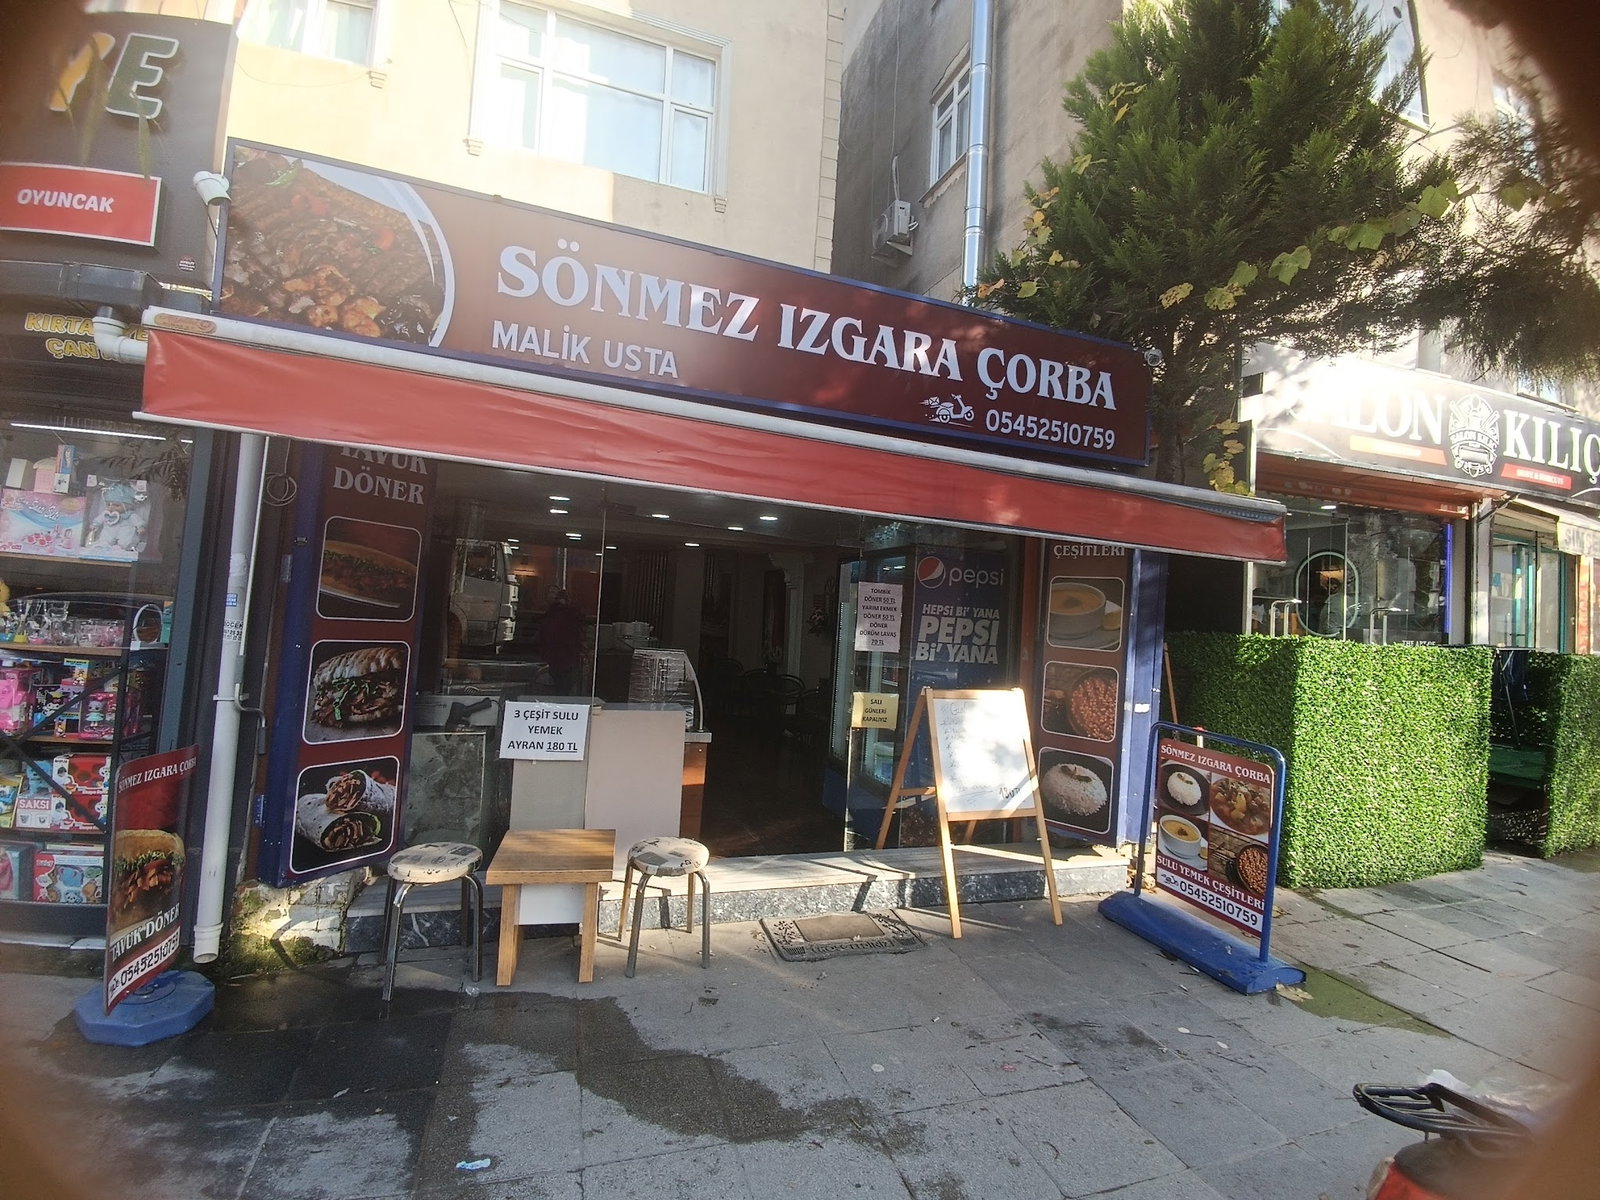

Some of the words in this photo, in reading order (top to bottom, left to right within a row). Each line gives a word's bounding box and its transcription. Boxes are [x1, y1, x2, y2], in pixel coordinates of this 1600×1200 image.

[17, 188, 115, 213] OYUNCAK
[497, 238, 760, 342] SÖNMEZ
[777, 303, 964, 382] IZGARA
[976, 347, 1117, 411] ÇORBA
[492, 320, 591, 365] MALİK
[603, 340, 679, 379] USTA
[985, 409, 1116, 451] 05452510759
[333, 465, 424, 505] DÖNER
[948, 567, 1005, 588] pepsi
[973, 607, 1000, 619] YANA
[947, 643, 999, 665] YANA
[514, 709, 521, 719] 3
[523, 708, 551, 721] ÇEŞİT
[552, 712, 579, 721] SULU
[528, 725, 563, 735] YEMEK
[507, 740, 544, 750] AYRAN
[546, 742, 565, 751] 180
[567, 742, 578, 751] TL
[144, 764, 178, 782] IZGARA
[1161, 744, 1196, 762] SÖNMEZ
[1197, 755, 1233, 773] IZGARA
[1234, 766, 1271, 784] ÇORBA
[1156, 855, 1178, 871] SULU
[1179, 865, 1210, 886] YEMEK
[1211, 880, 1265, 910] ÇEŞİTLERİ
[1179, 880, 1258, 926] 05452510759
[110, 926, 143, 962] TAVUK
